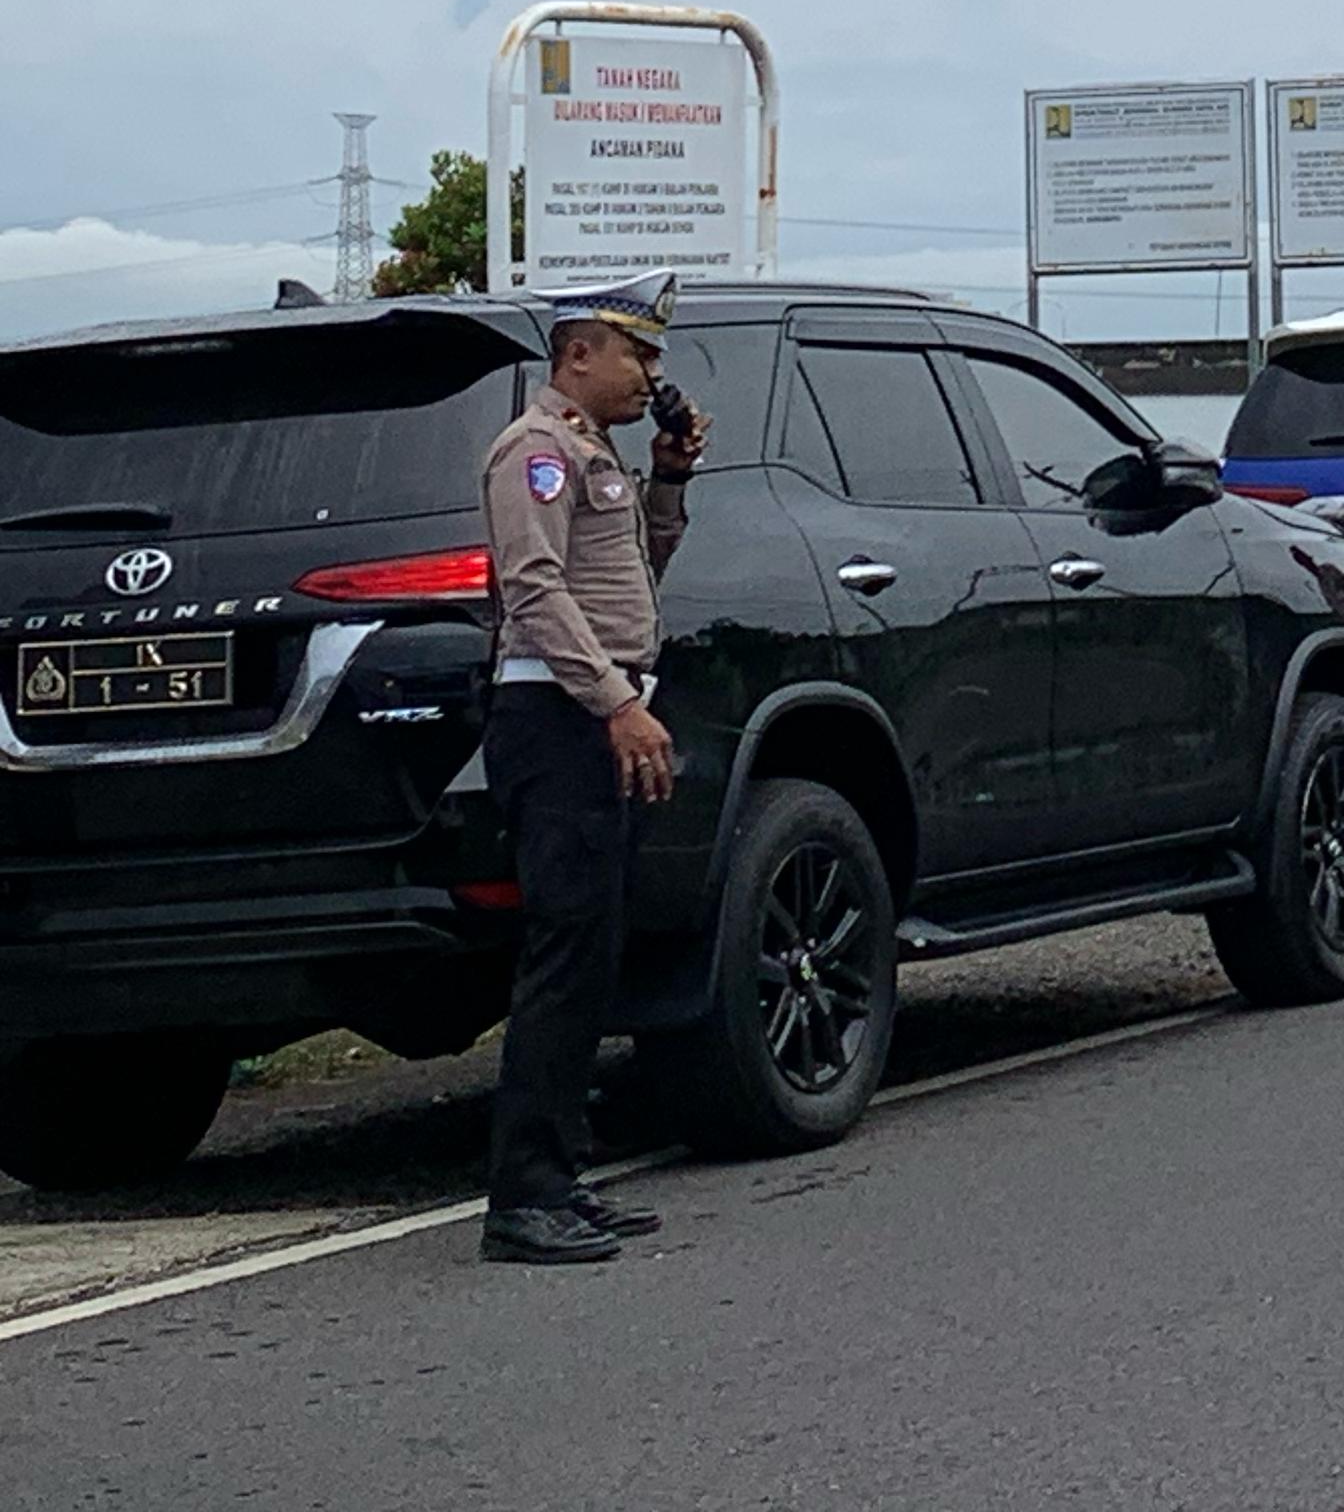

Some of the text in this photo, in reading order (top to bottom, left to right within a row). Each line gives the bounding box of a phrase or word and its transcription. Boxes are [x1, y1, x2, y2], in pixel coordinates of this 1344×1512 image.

[596, 67, 681, 90] TANAH NEGARA
[554, 99, 602, 121] DILARANG
[590, 139, 685, 159] ANCAMAN PIDANA
[136, 640, 163, 667] IX
